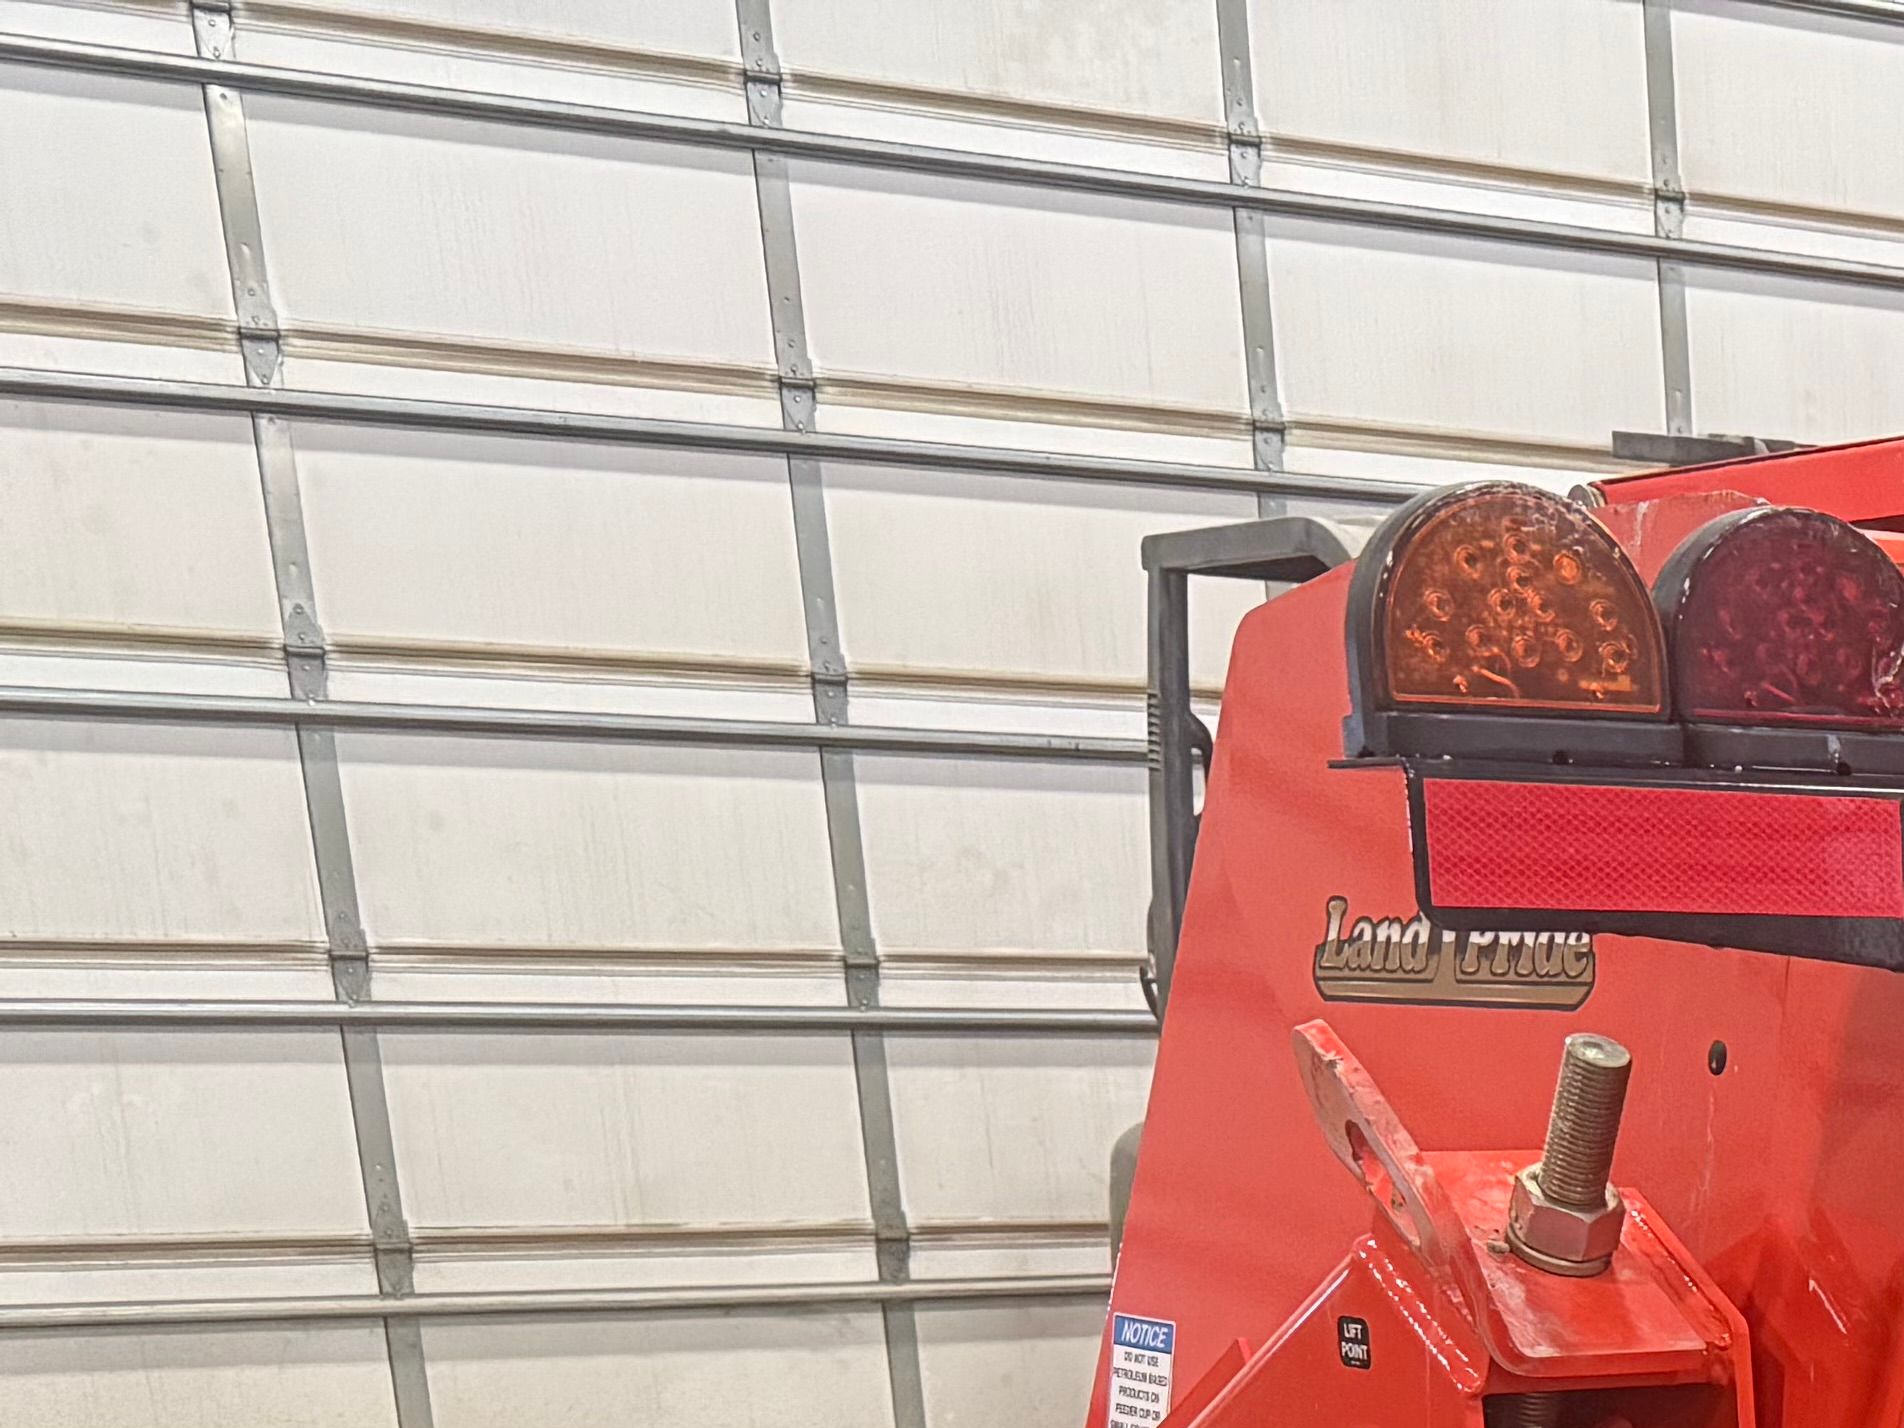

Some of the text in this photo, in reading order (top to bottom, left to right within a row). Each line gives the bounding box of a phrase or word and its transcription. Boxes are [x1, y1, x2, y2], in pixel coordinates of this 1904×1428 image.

[1316, 895, 1433, 973] Land
[1121, 1320, 1168, 1348] NOTICE
[1344, 1323, 1362, 1339] LIFT
[1341, 1341, 1368, 1360] POINT
